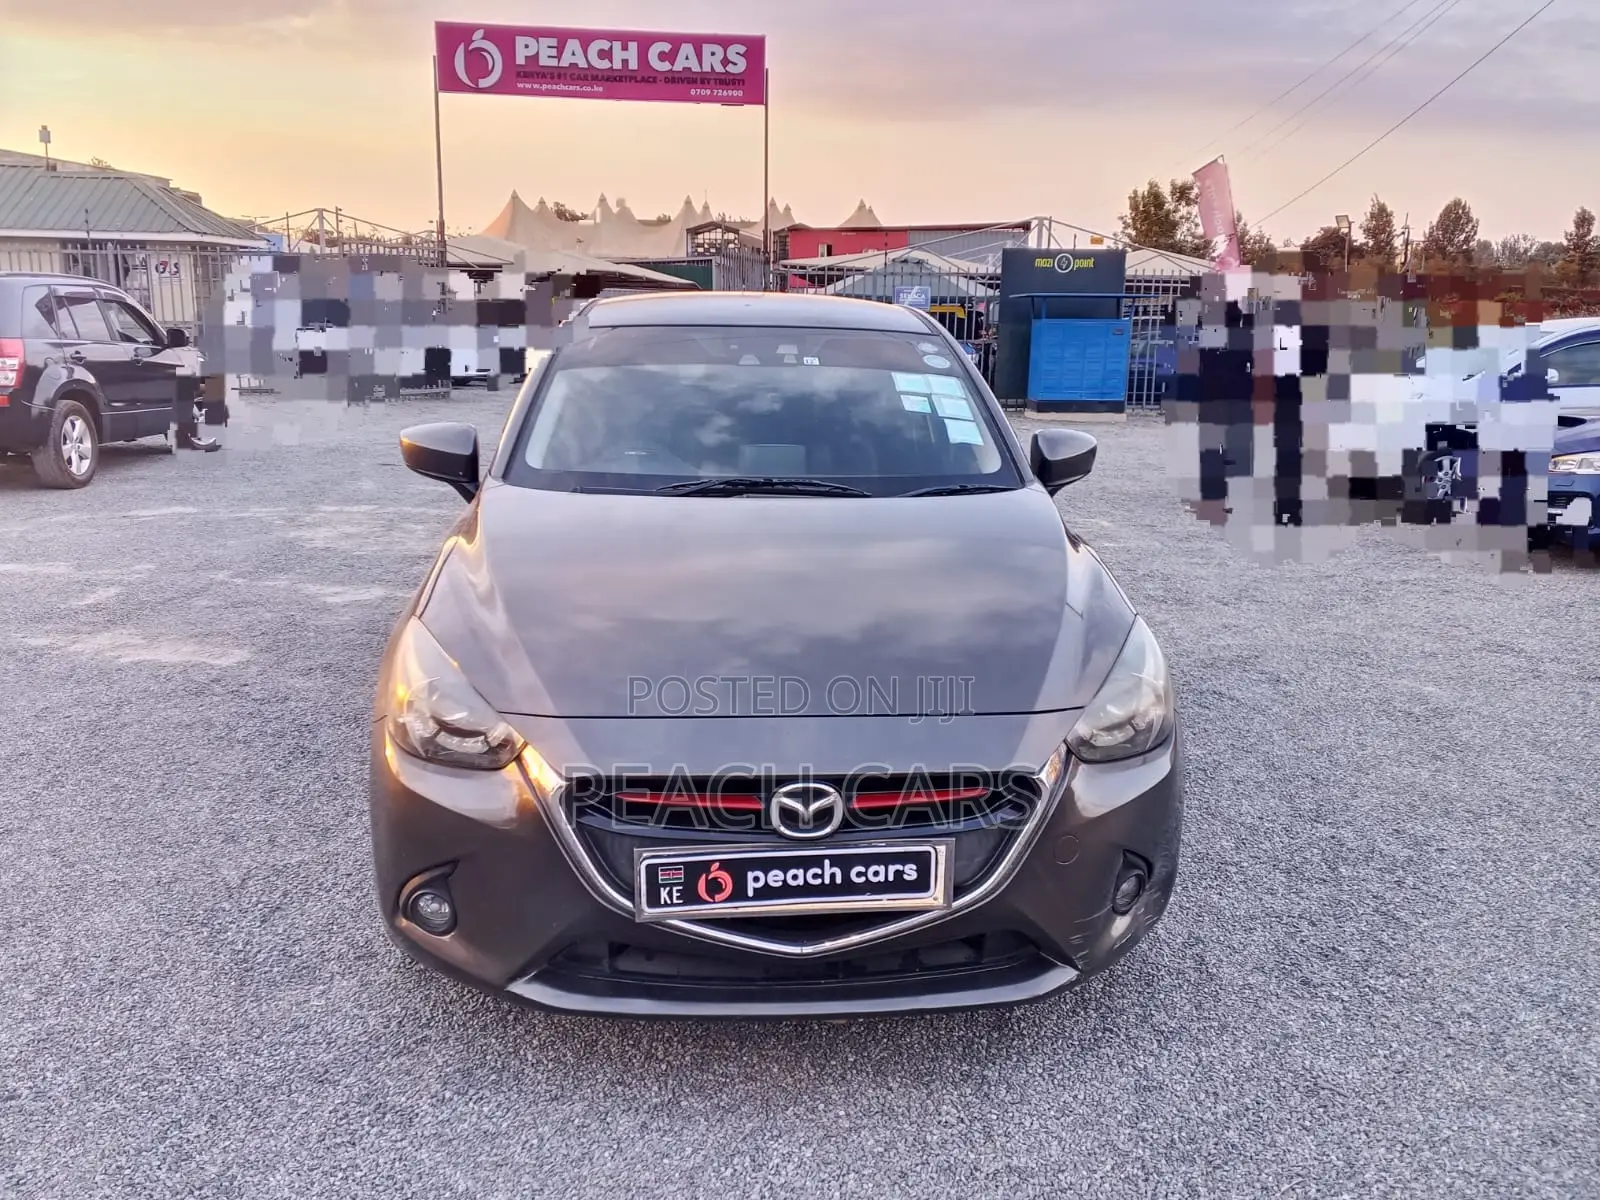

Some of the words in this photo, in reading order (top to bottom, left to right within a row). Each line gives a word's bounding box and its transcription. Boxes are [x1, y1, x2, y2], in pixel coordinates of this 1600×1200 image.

[515, 36, 638, 71] PEACH
[648, 40, 747, 74] CARS
[569, 73, 589, 82] CAR
[590, 74, 657, 84] MARKETPLACE
[664, 77, 698, 85] DRIVEN
[516, 82, 603, 92] www.peachcars.co.ke
[713, 89, 743, 97] 726900
[1035, 257, 1053, 268] mazi
[1074, 257, 1095, 271] point
[746, 858, 843, 897] peach
[850, 862, 919, 885] cars
[660, 887, 684, 905] KE
